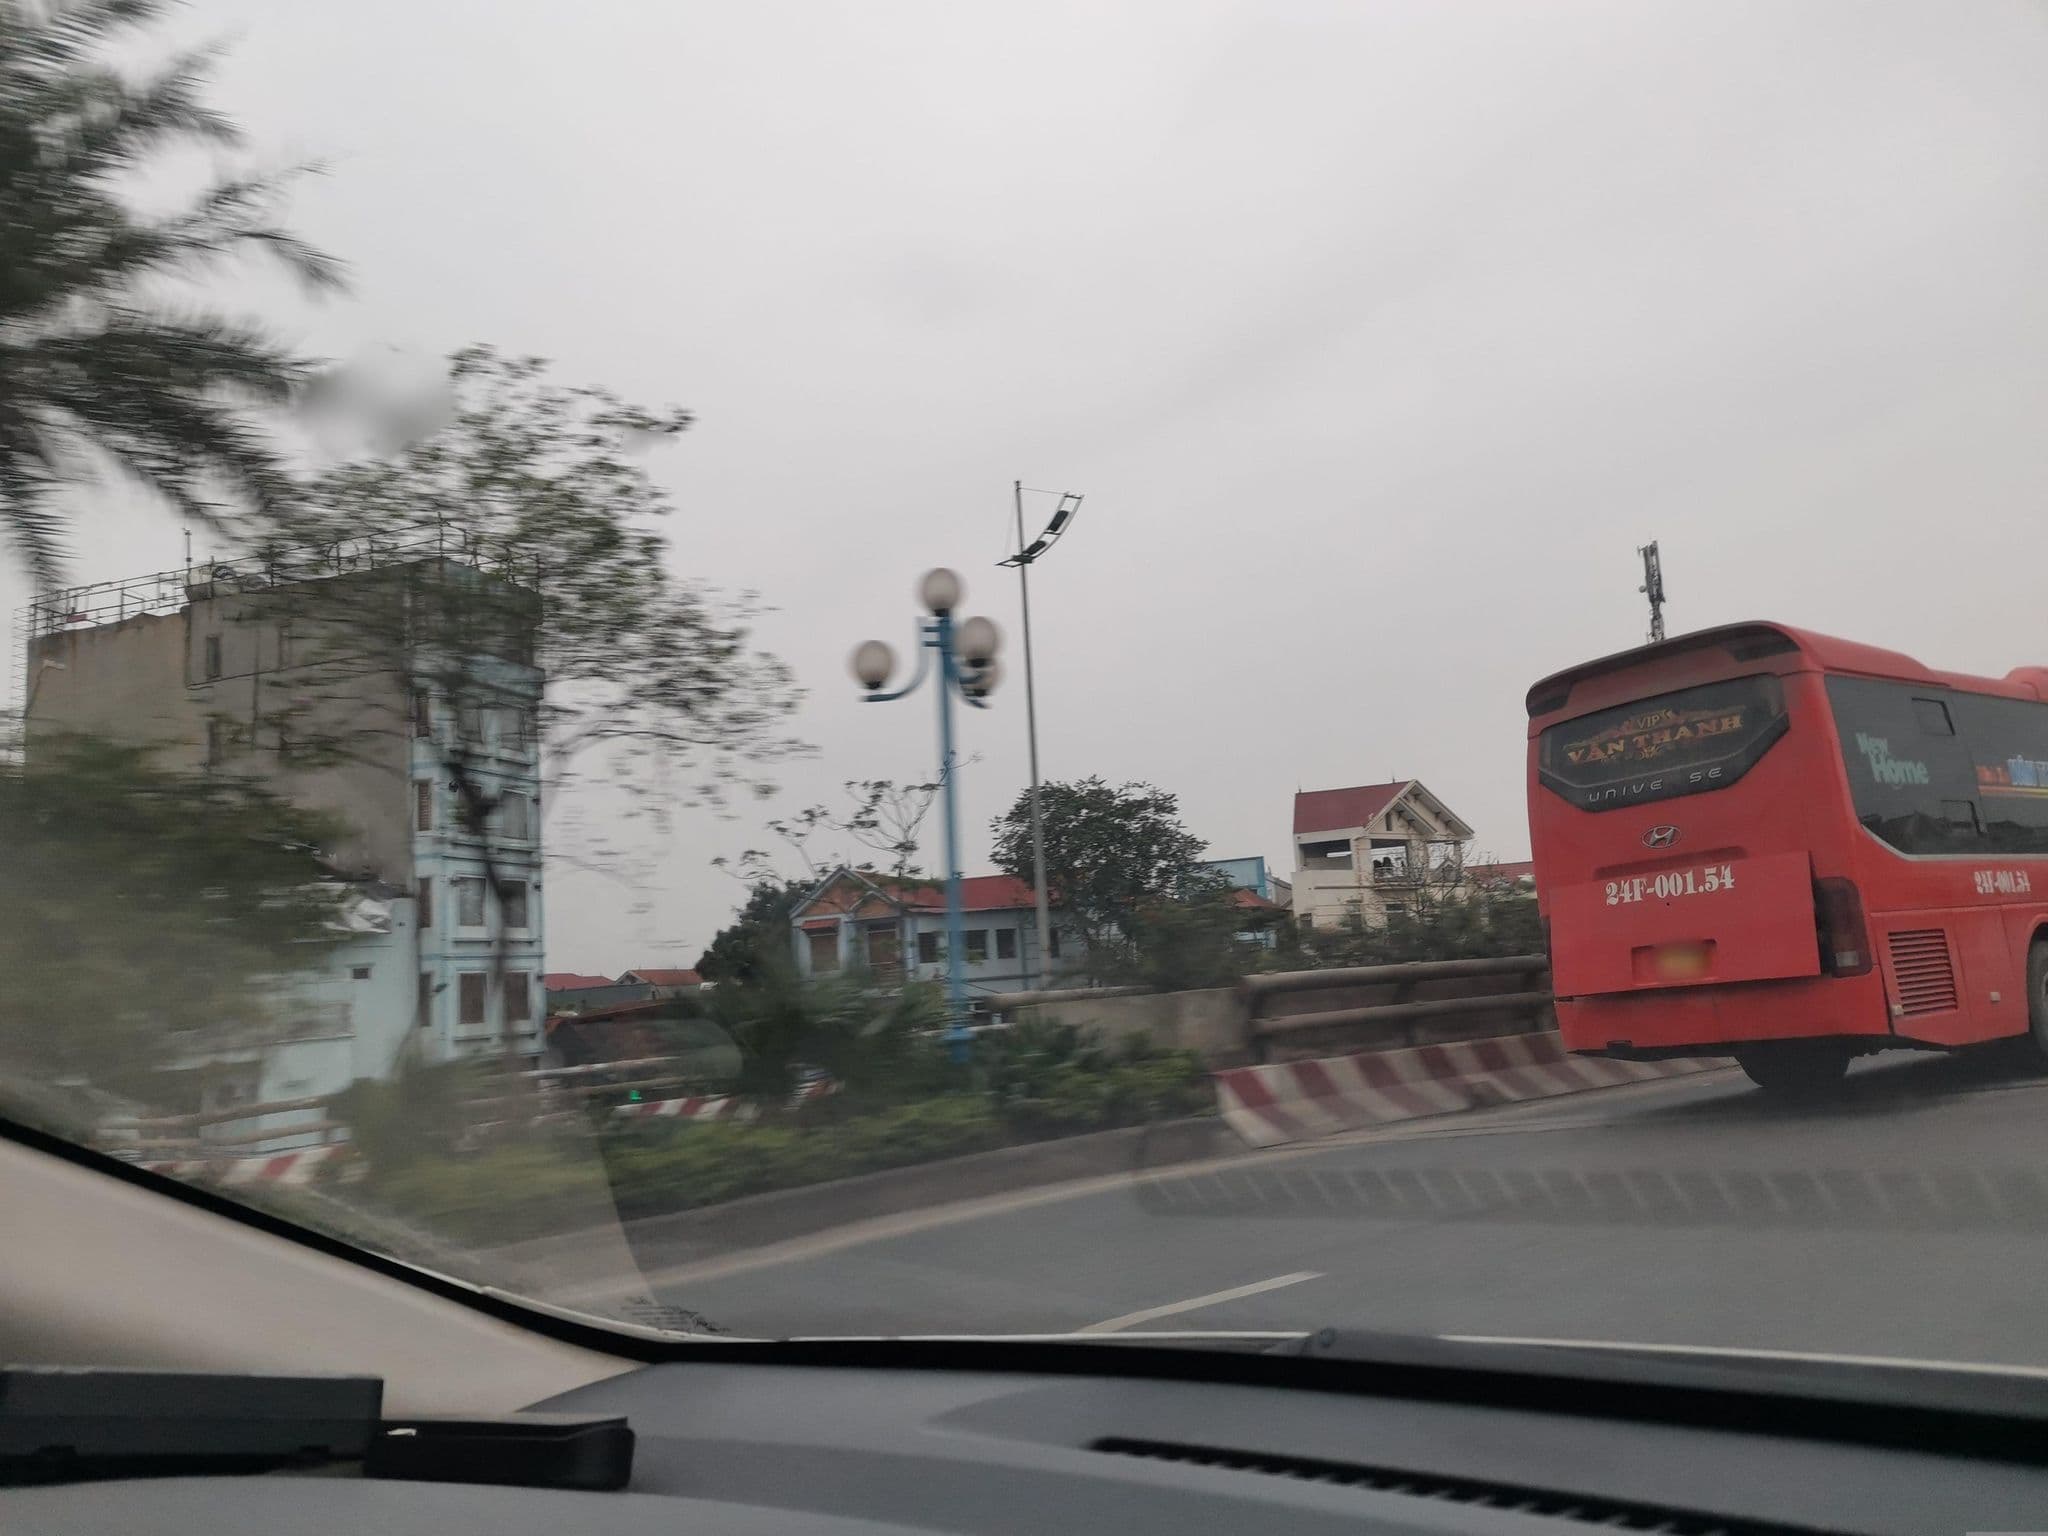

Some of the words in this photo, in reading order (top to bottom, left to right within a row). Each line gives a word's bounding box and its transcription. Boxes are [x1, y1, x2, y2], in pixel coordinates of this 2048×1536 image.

[1637, 713, 1660, 730] VIP
[1869, 751, 1929, 785] Home
[1605, 864, 1735, 906] 24F-001.54
